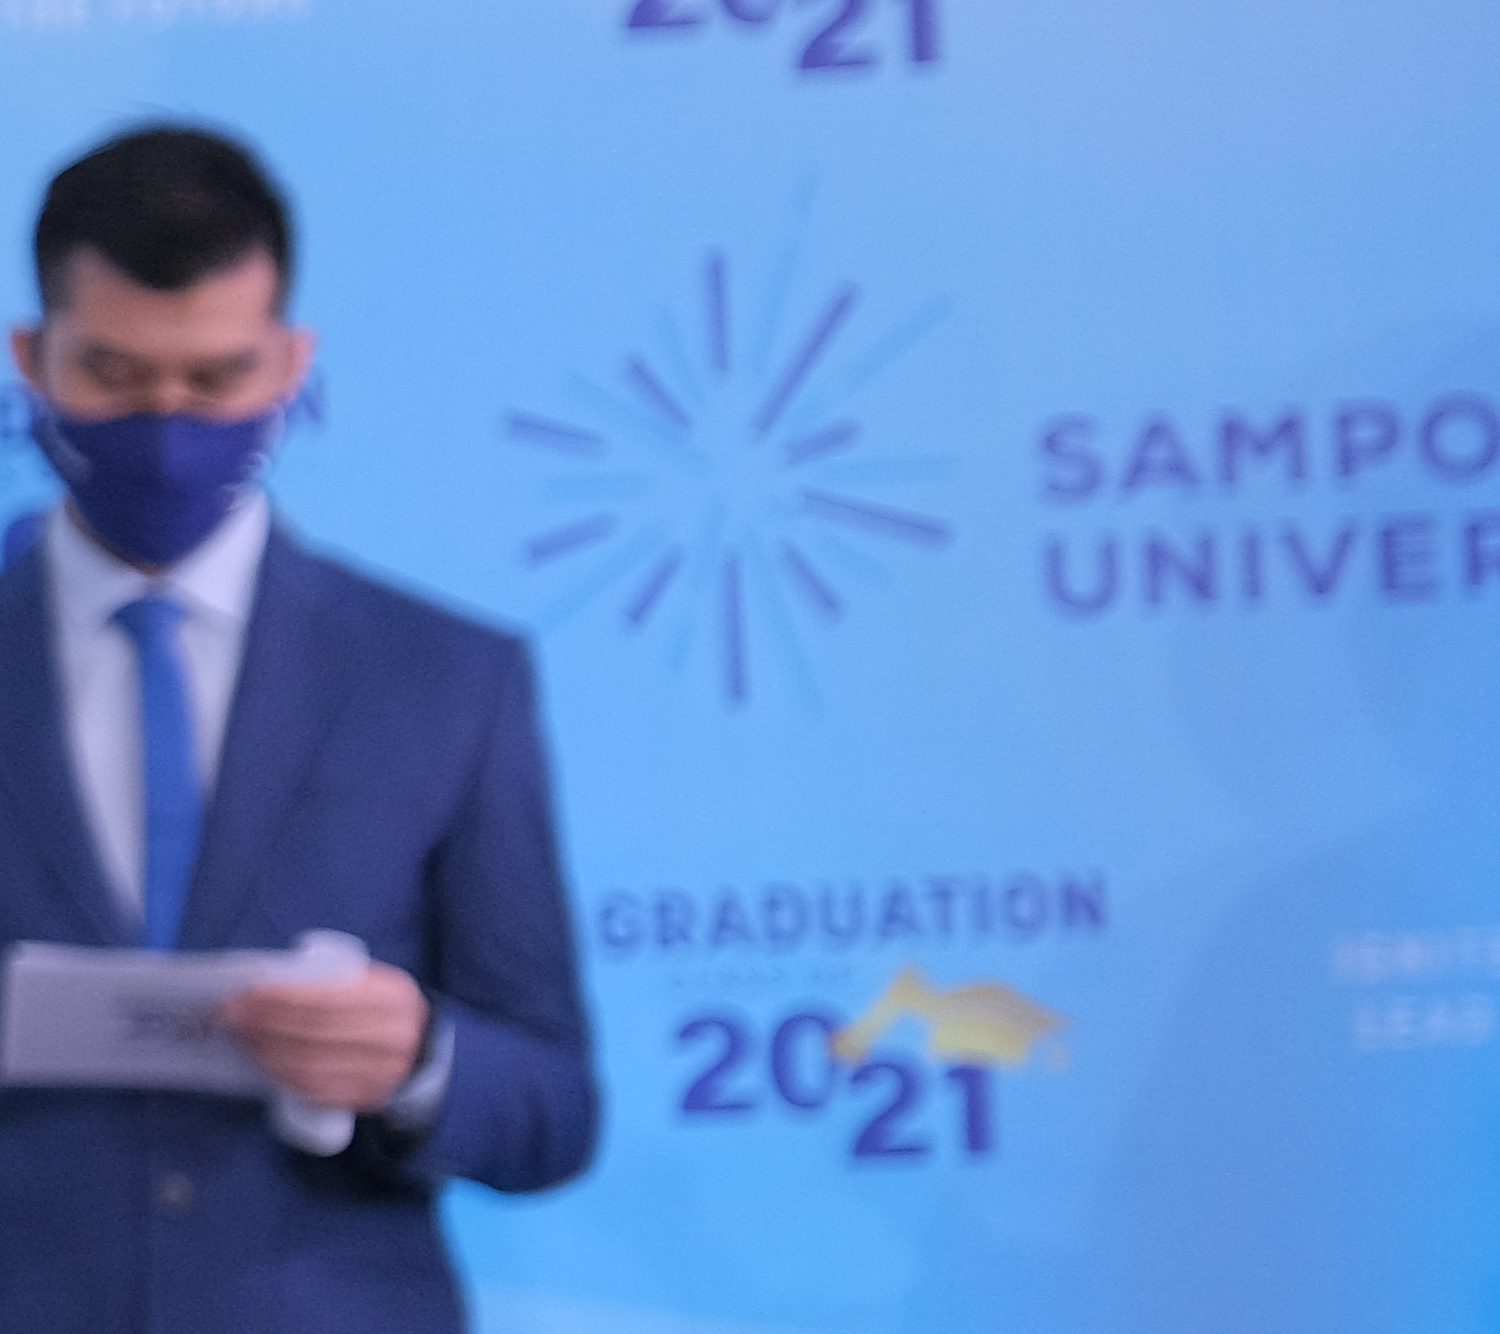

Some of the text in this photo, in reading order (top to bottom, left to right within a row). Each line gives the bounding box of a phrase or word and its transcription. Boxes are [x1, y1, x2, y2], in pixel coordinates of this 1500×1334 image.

[1038, 391, 1500, 507] SAMPO
[598, 871, 1109, 955] GRADUATION
[675, 1006, 996, 1161] 2021
